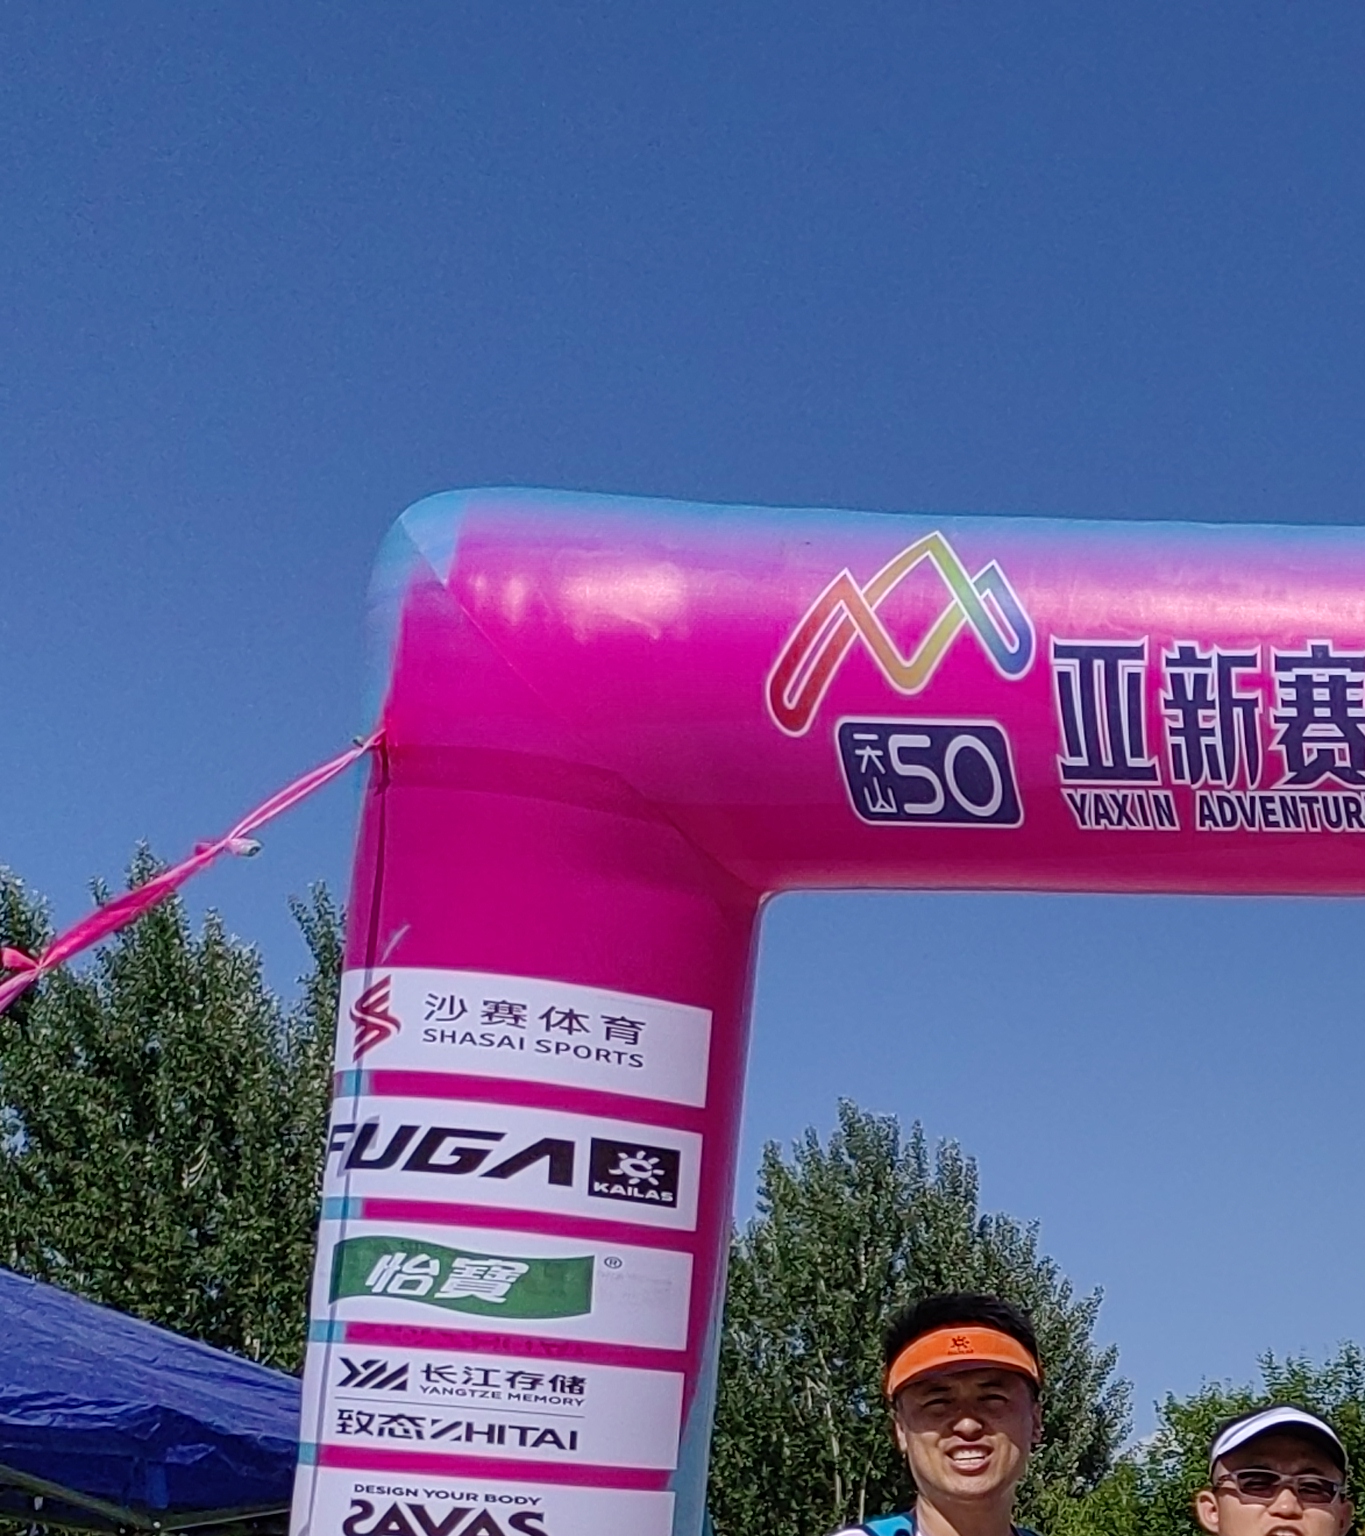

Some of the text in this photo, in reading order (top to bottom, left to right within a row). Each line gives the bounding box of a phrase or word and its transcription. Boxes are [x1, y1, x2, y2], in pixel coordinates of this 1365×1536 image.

[889, 733, 1002, 817] 50
[1067, 789, 1178, 831] YAXIN
[423, 992, 647, 1046] 沙赛体育
[421, 1027, 645, 1068] SHASAI SPORTS
[593, 1181, 674, 1202] KAILAS
[364, 1252, 530, 1304] 怡寶
[419, 1384, 586, 1408] YANGTZE MEMORY
[420, 1361, 587, 1396] 长江存储
[354, 1483, 543, 1507] DESIGN YOUR BODY
